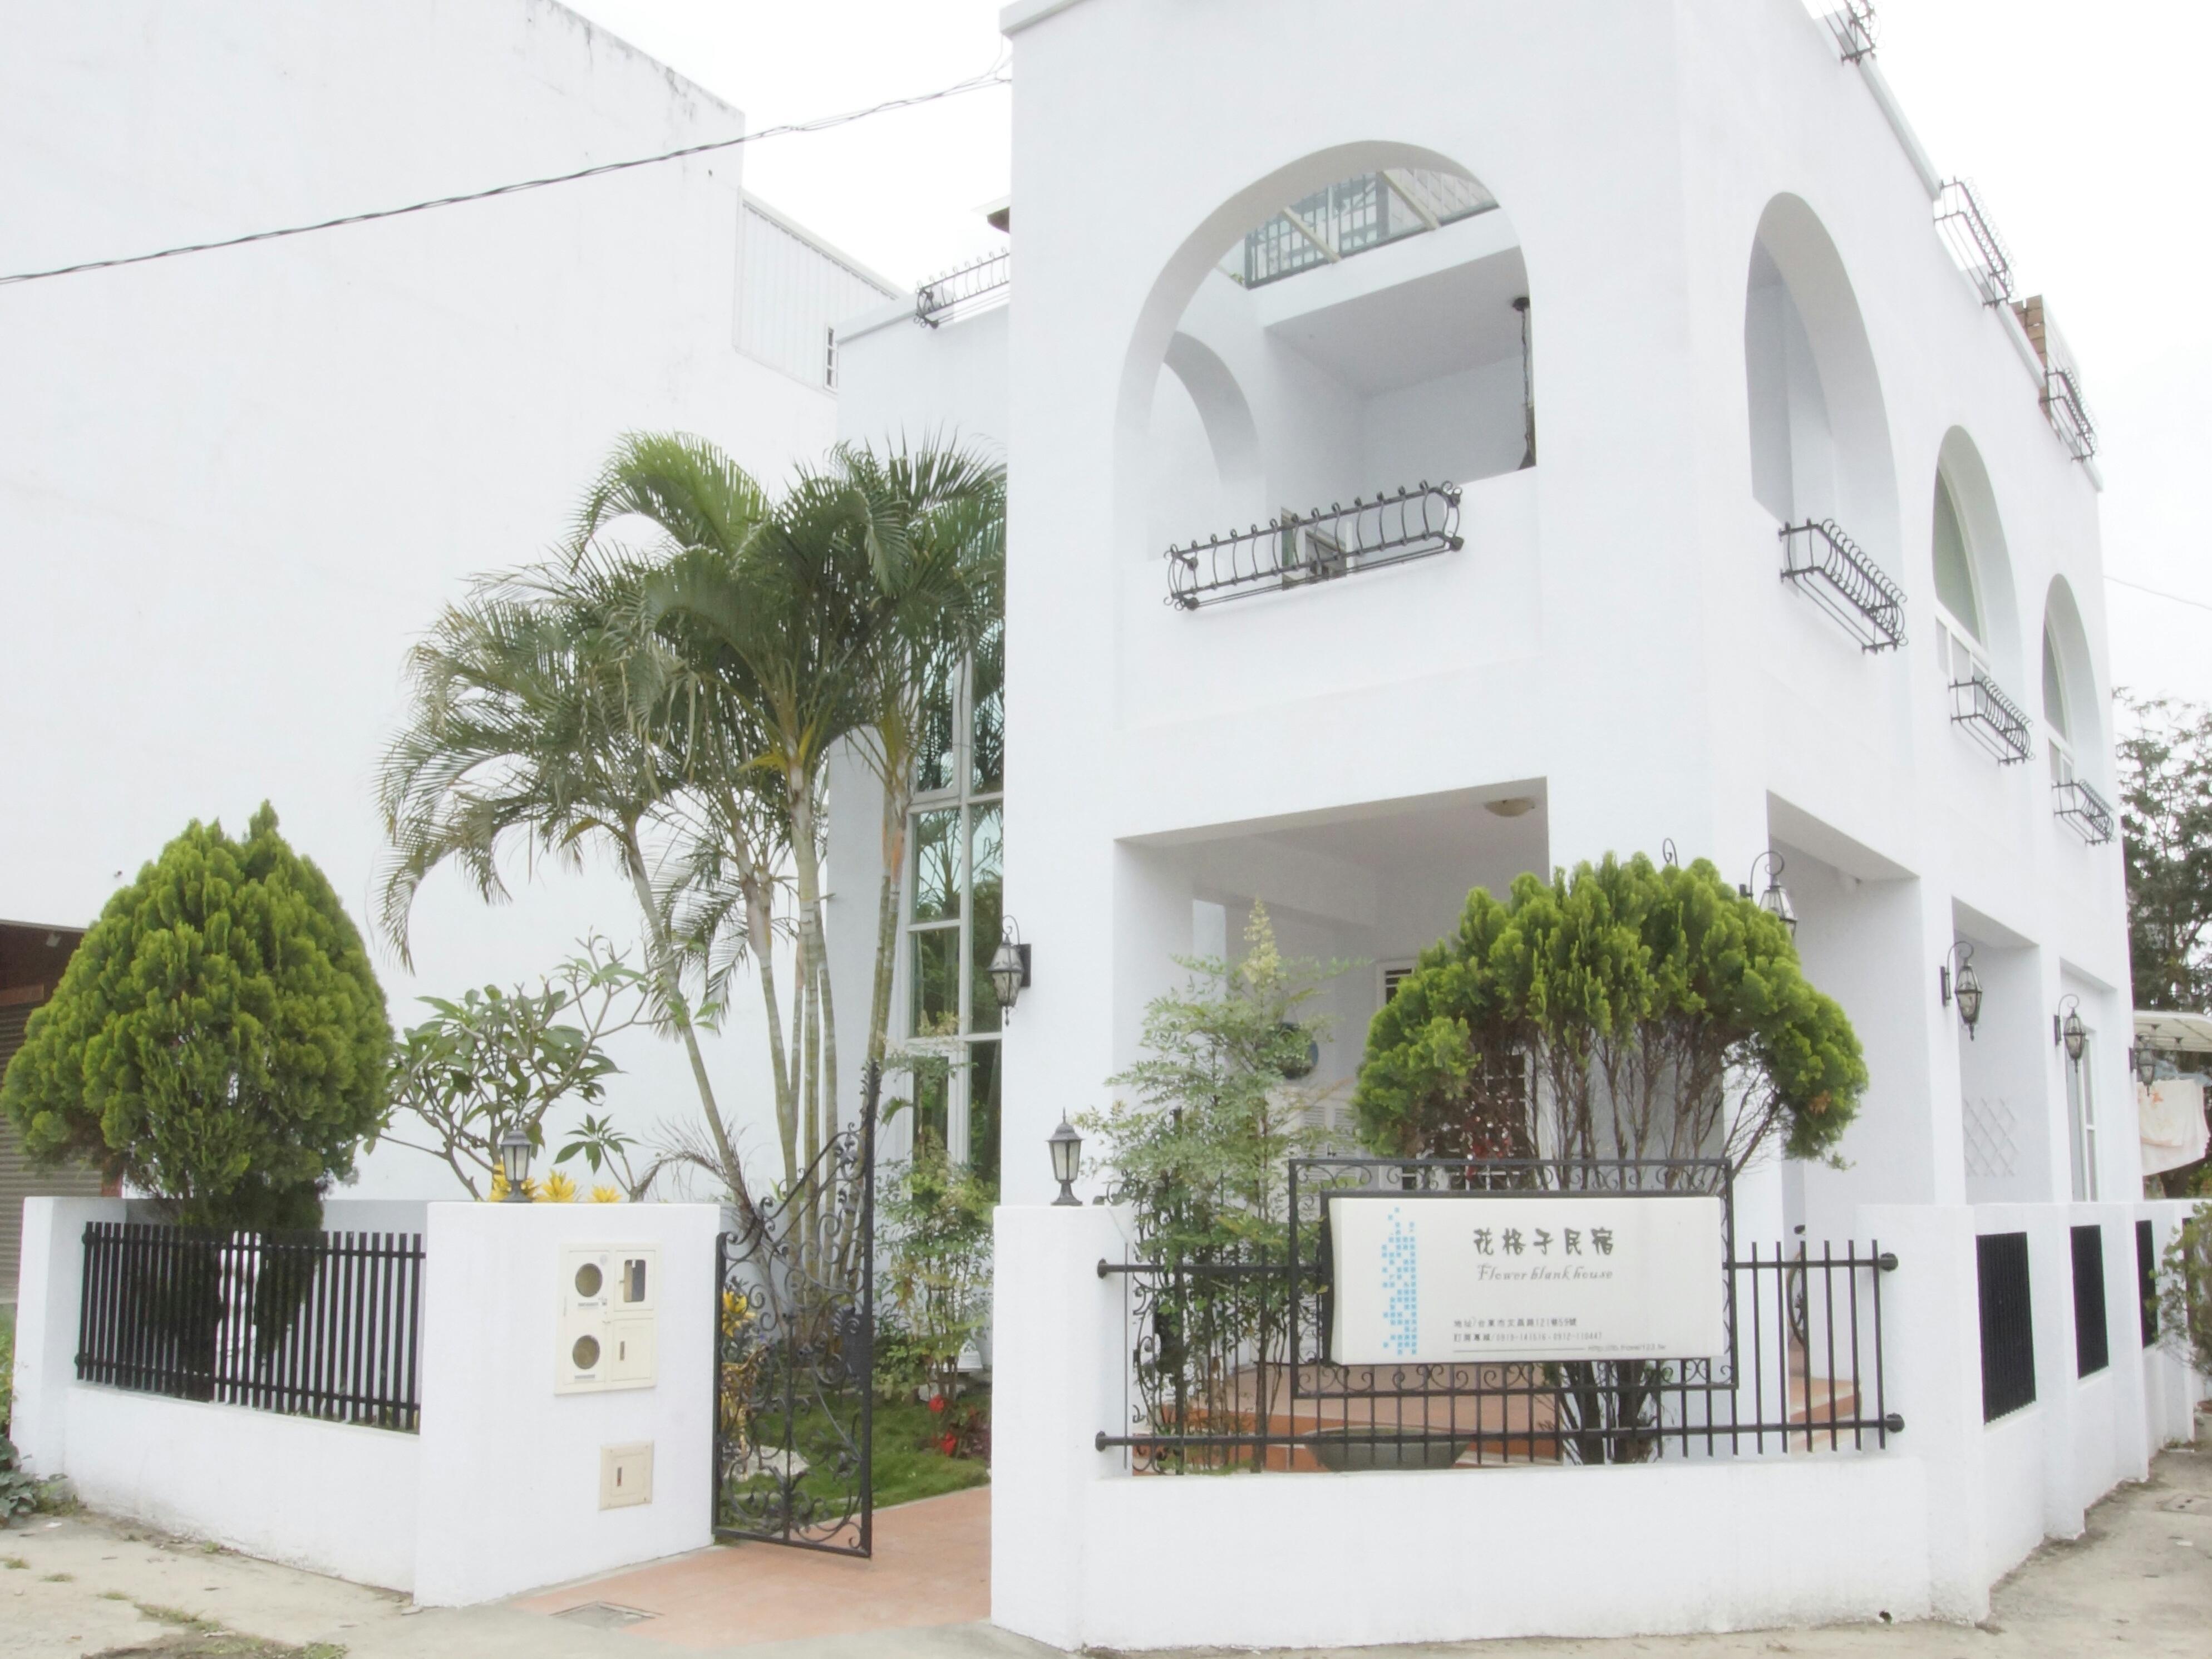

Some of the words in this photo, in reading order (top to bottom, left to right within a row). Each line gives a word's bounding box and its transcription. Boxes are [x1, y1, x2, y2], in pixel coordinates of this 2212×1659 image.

[1474, 1227, 1613, 1255] 花格子民宿
[1477, 1263, 1527, 1281] Flower
[1573, 1265, 1613, 1280] house
